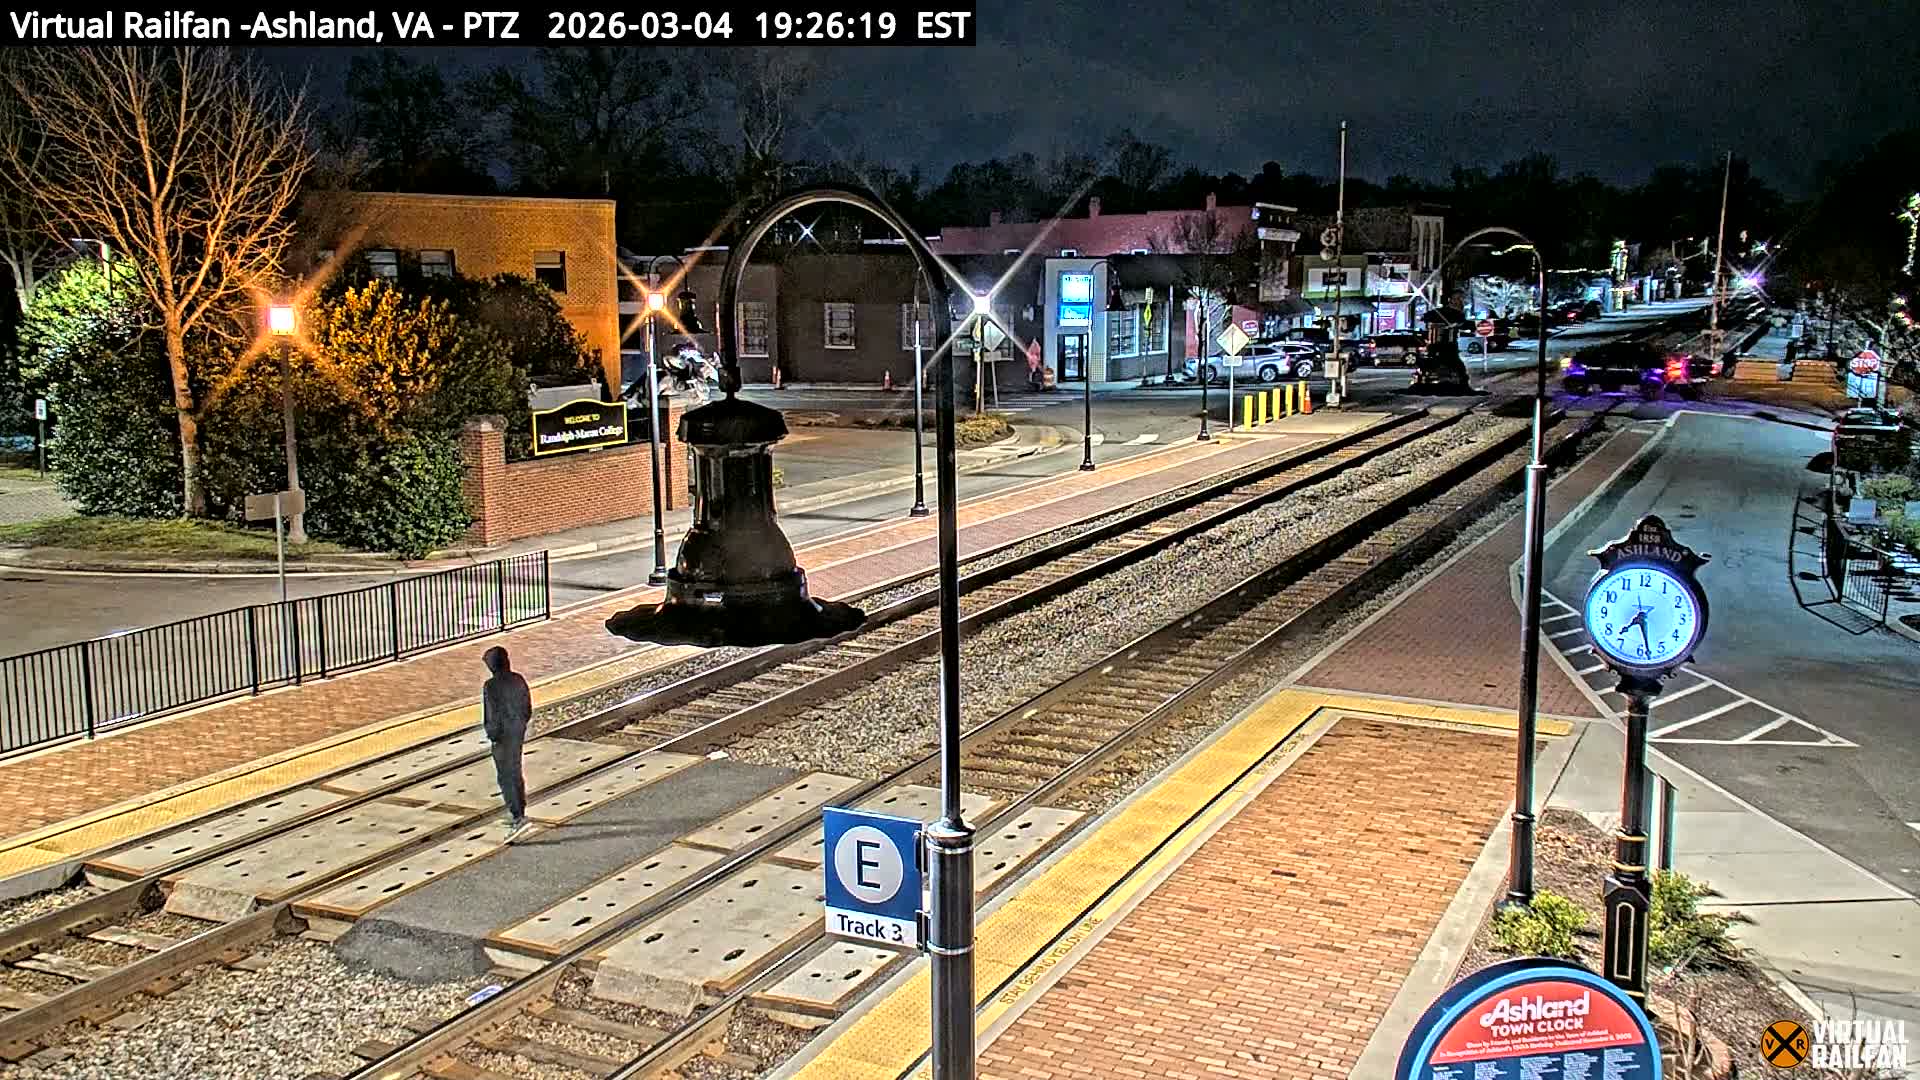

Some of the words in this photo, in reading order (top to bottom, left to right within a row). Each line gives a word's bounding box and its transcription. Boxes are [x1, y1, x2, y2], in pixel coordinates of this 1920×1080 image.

[1851, 358, 1877, 368] STOP
[1617, 545, 1682, 562] ASHLAND
[1622, 578, 1631, 591] 11
[1639, 574, 1652, 587] 12
[1662, 582, 1667, 594] 1
[1606, 591, 1617, 603] 10
[1675, 596, 1682, 608] 2
[1601, 607, 1608, 618] 9
[1679, 614, 1686, 625] 3
[1605, 623, 1613, 636] 8
[1672, 629, 1679, 641] 4
[1617, 638, 1625, 650] 7
[1657, 642, 1665, 654] 5
[1637, 645, 1644, 657] 6
[856, 840, 880, 889] E
[837, 914, 886, 939] Track
[892, 923, 903, 940] 3
[1480, 991, 1590, 1027] Ashland
[1491, 1024, 1534, 1038] TOWN
[1537, 1017, 1583, 1033] CLOCK
